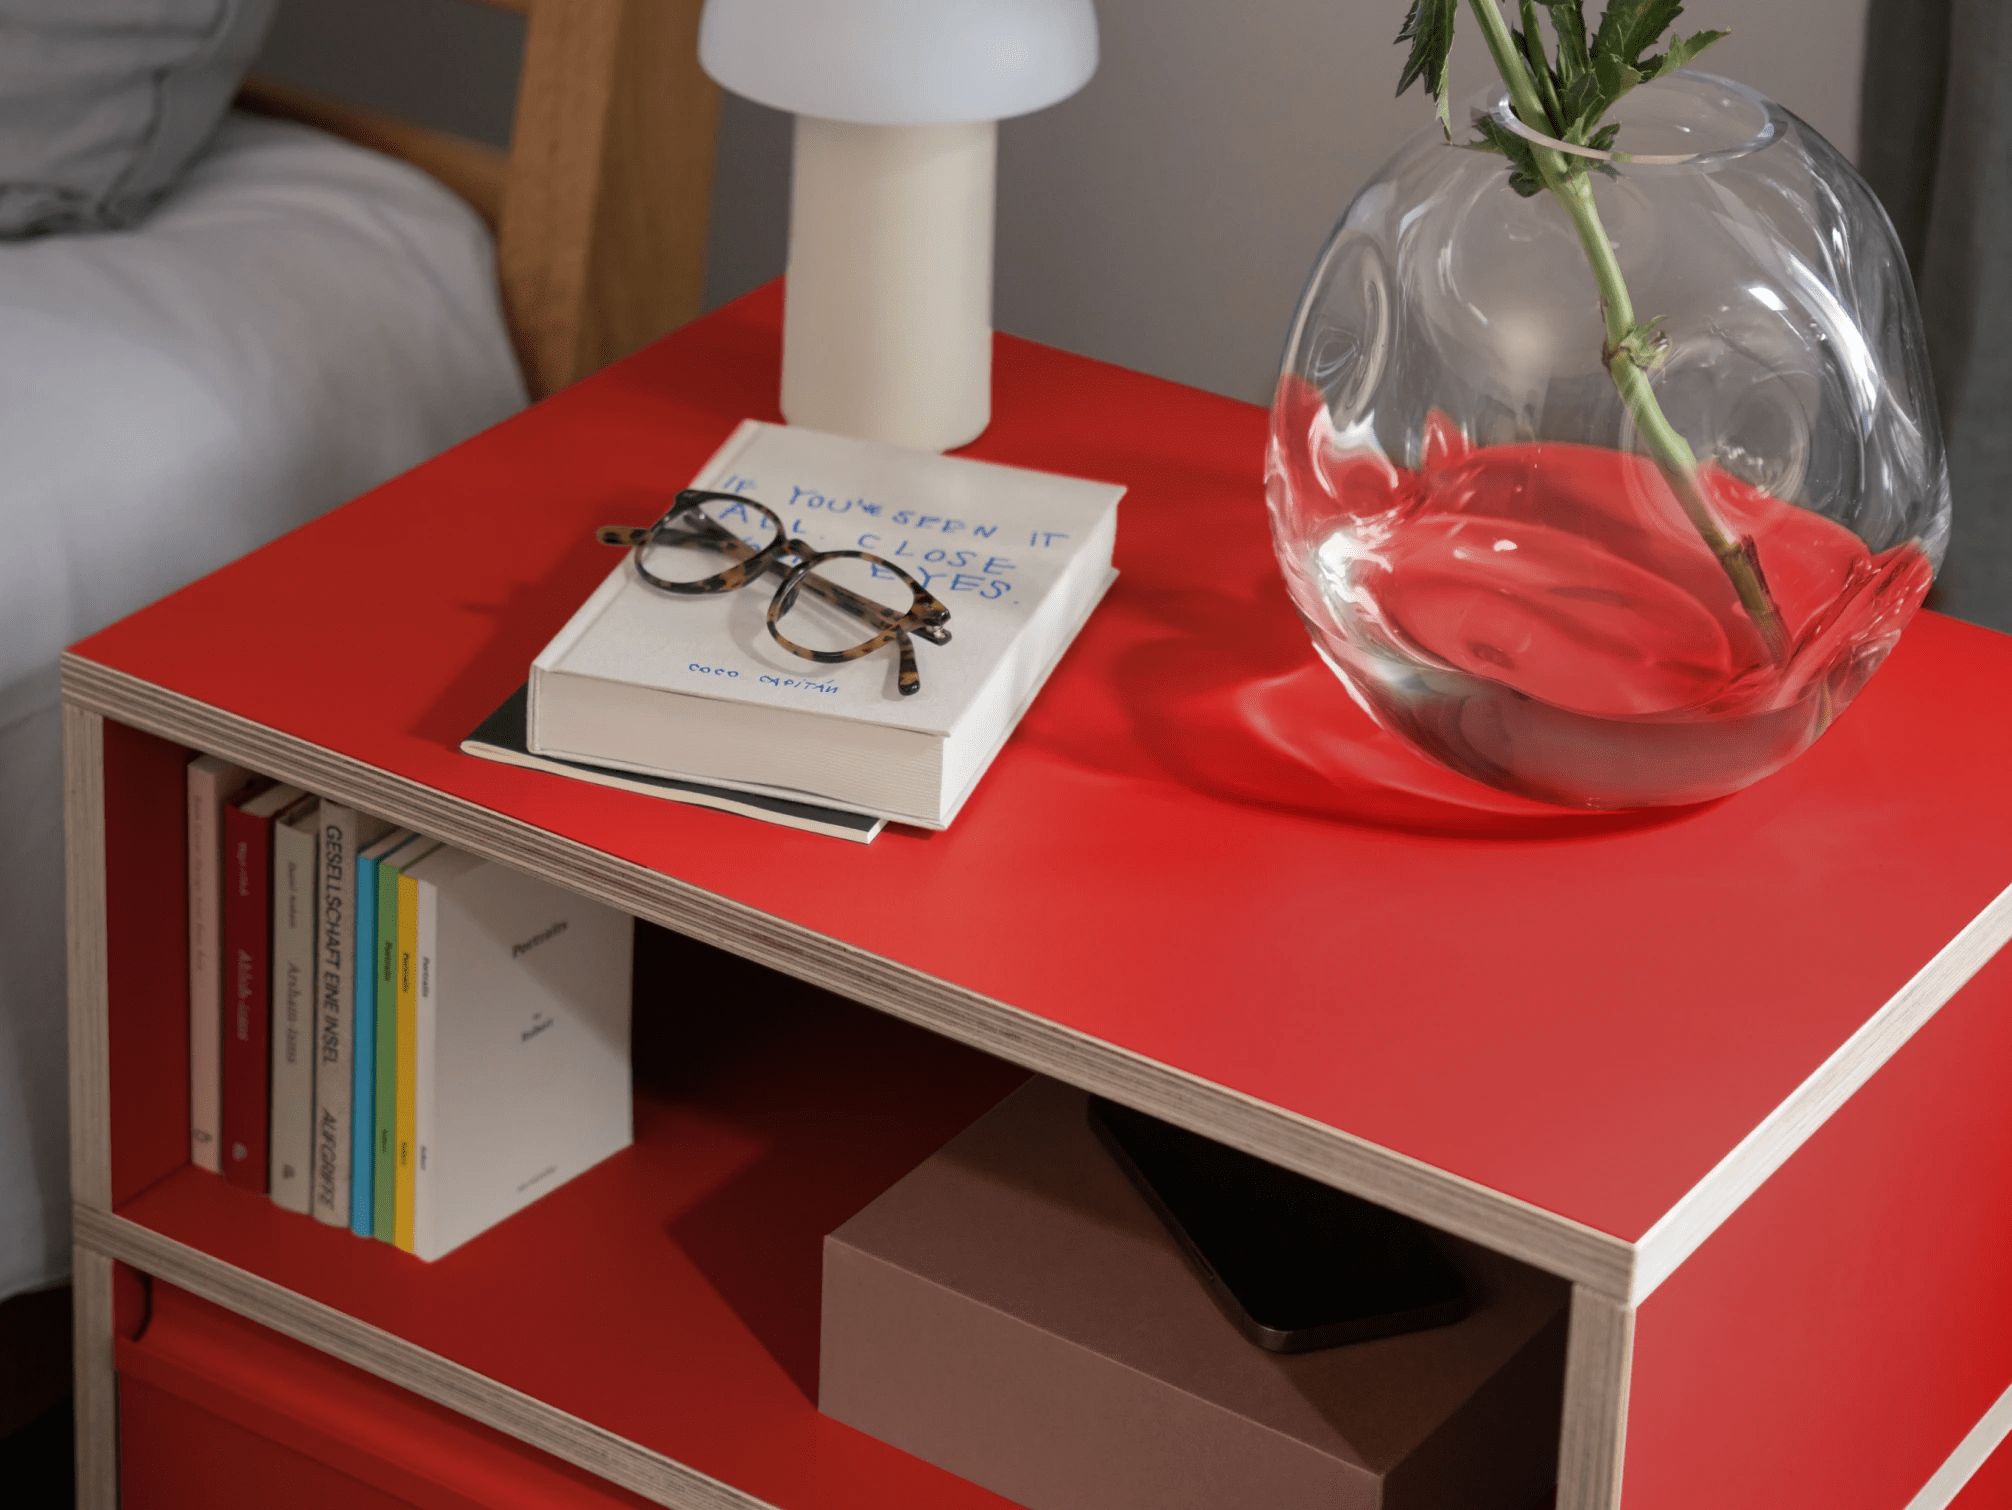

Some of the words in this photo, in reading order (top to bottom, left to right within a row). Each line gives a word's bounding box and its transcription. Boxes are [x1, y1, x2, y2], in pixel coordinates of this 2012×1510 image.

[891, 510, 998, 538] SEEN
[1030, 531, 1070, 547] IT
[857, 533, 1017, 574] CLOSE
[871, 562, 1019, 605] EYES.
[688, 663, 739, 677] COCO
[325, 824, 343, 972] GESELLSCHAFT
[323, 970, 340, 1014] EINE
[322, 1014, 339, 1066] INSEL
